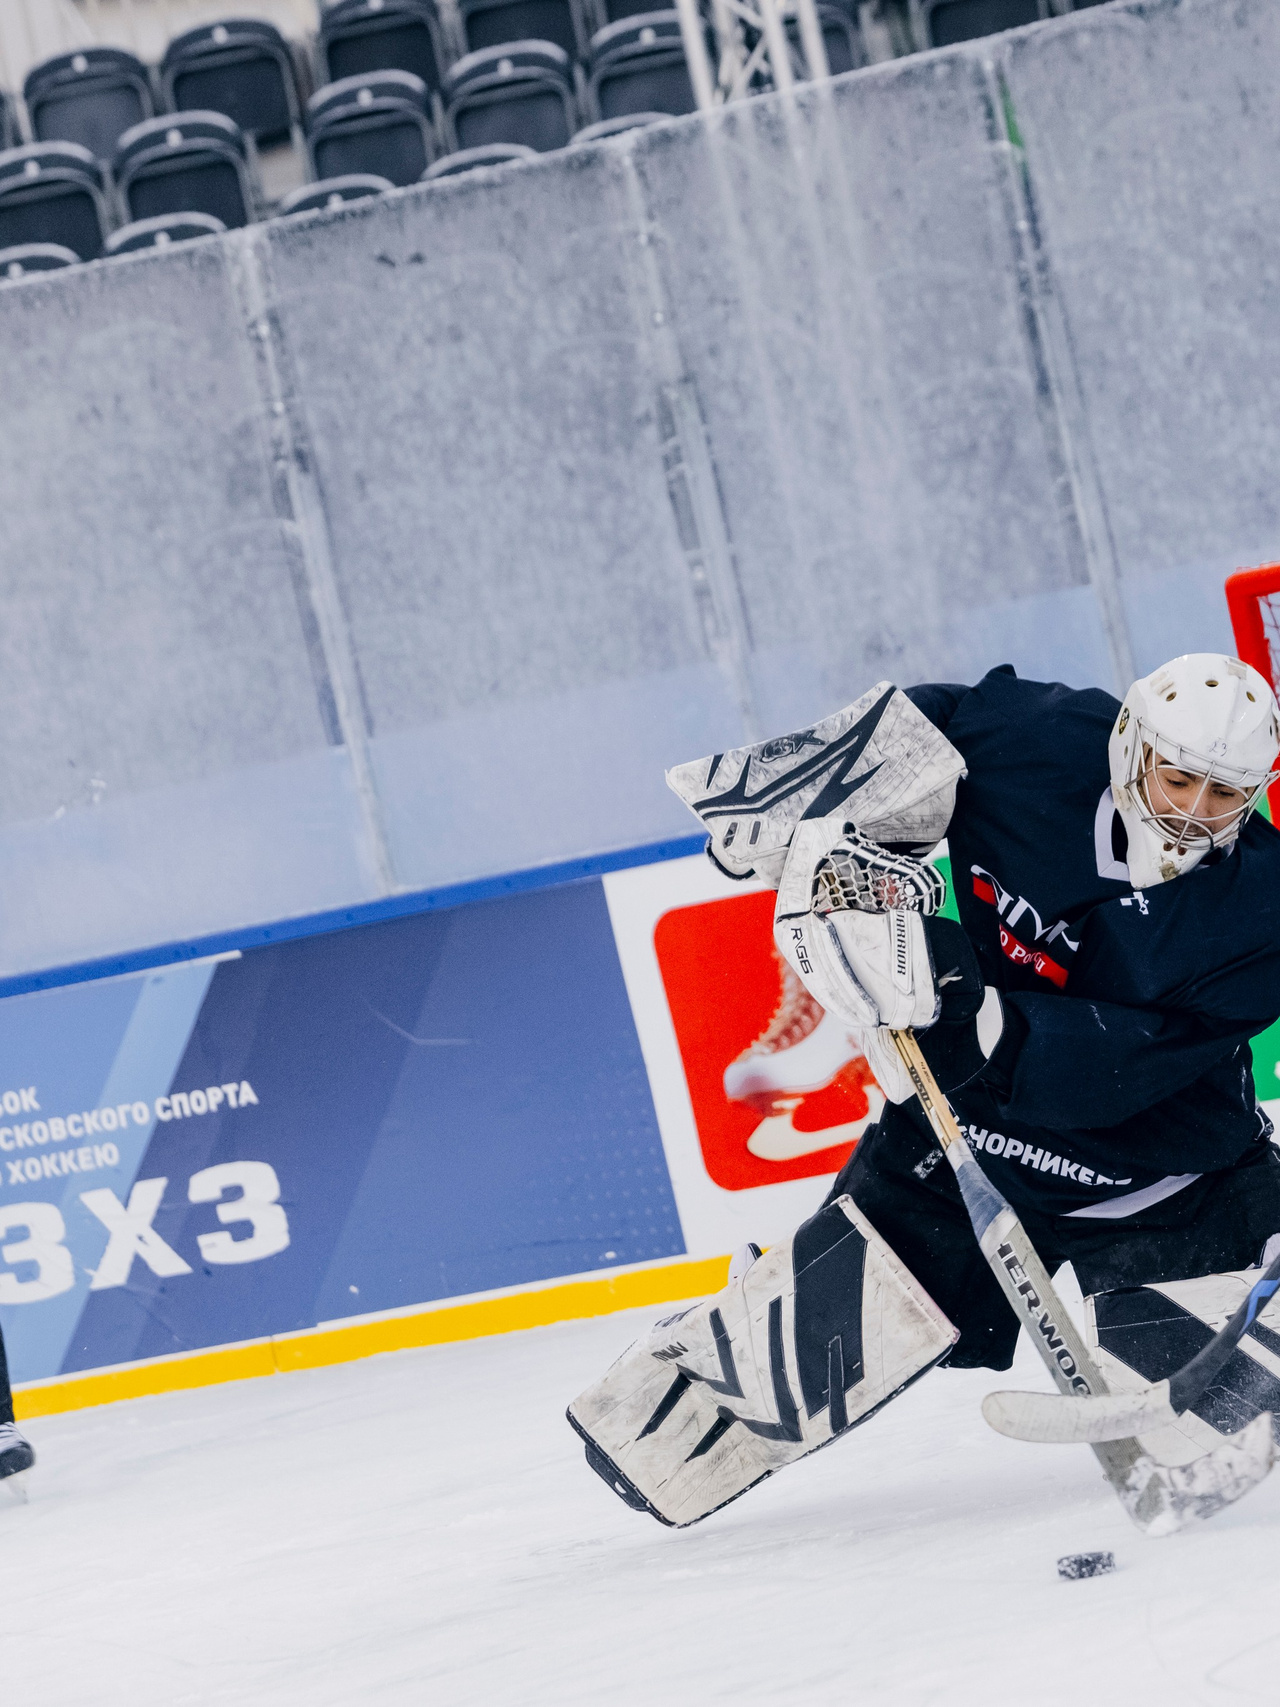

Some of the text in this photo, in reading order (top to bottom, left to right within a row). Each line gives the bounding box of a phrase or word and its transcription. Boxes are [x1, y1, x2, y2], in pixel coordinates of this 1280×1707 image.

[0, 1086, 41, 1118] ОК
[154, 1080, 259, 1121] СПОРТА
[6, 1142, 120, 1185] ХОККЕЮ
